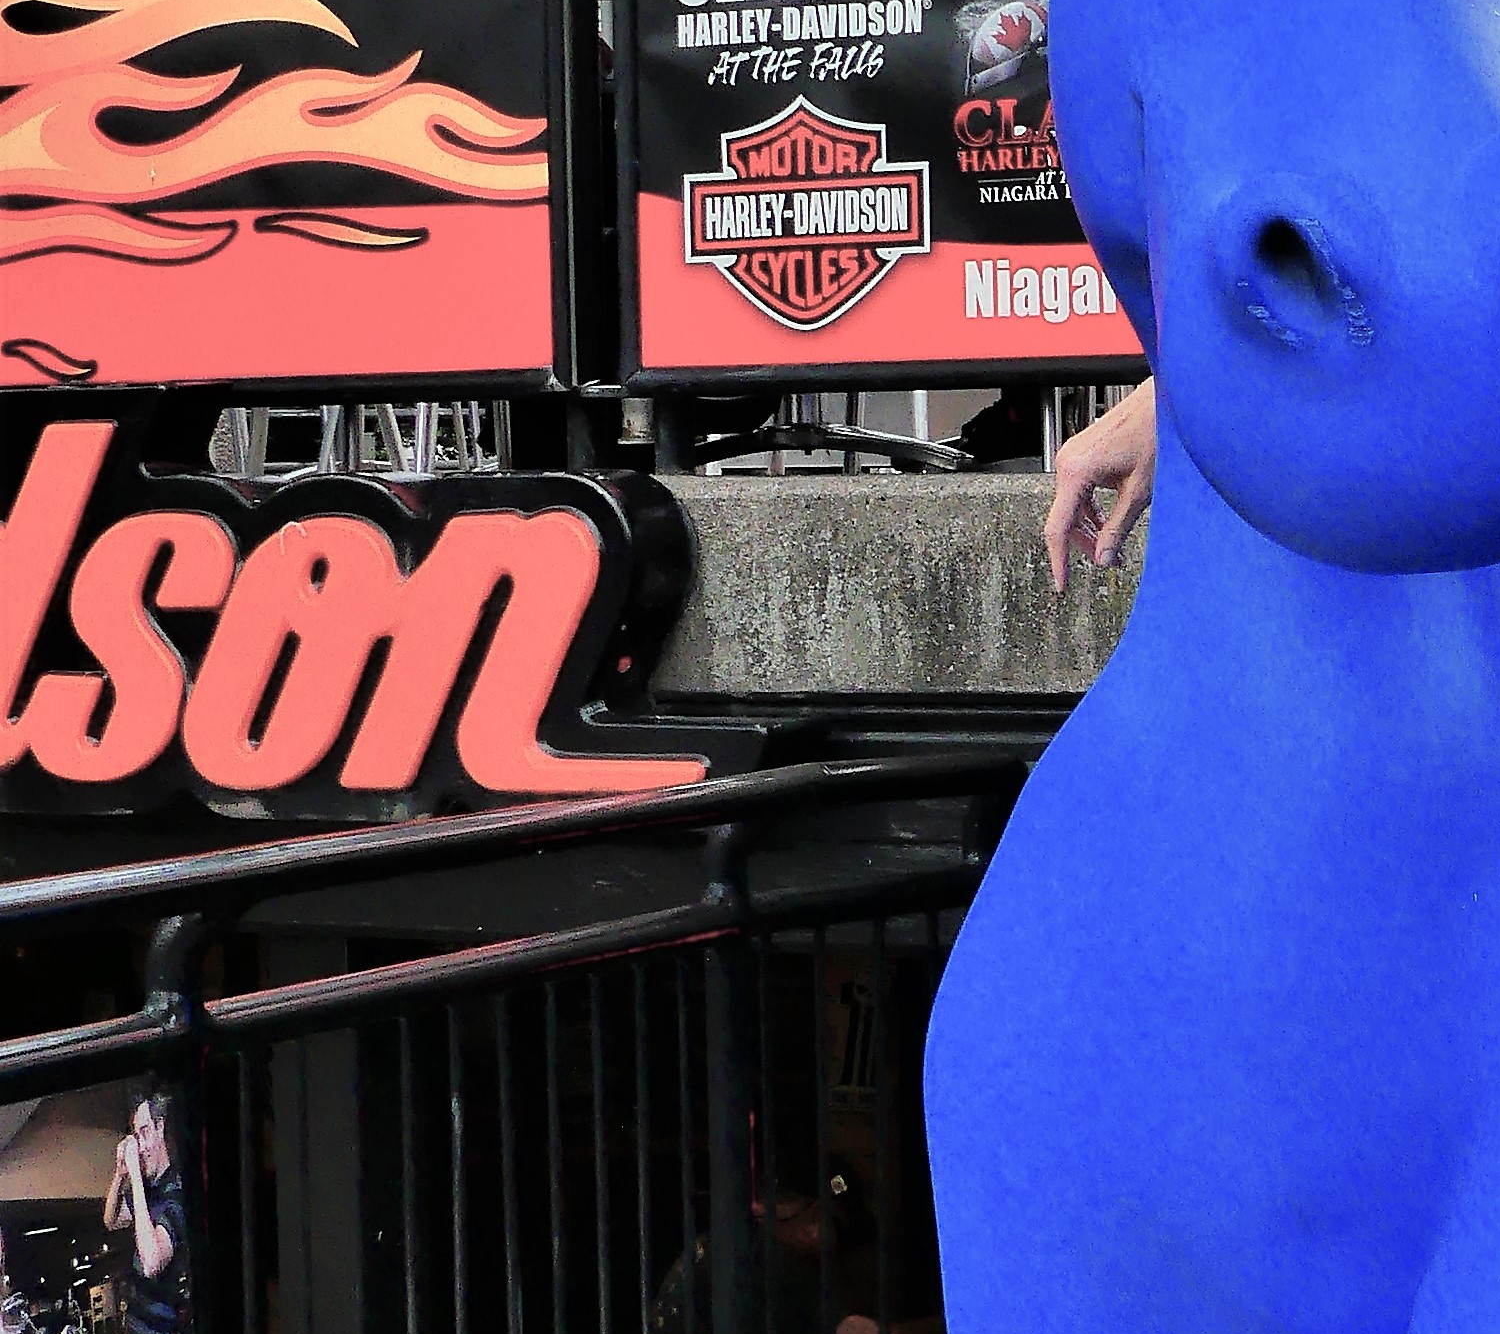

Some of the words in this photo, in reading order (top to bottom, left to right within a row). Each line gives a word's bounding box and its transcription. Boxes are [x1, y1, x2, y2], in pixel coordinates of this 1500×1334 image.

[707, 51, 751, 86] AT
[749, 45, 804, 84] THE
[809, 40, 885, 82] FALLS
[748, 125, 859, 178] MOTOR
[979, 183, 1060, 203] NIAGARA
[1034, 169, 1055, 185] AT
[705, 187, 909, 240] HARLEY-DAVIDSON
[751, 248, 861, 308] CYCLES
